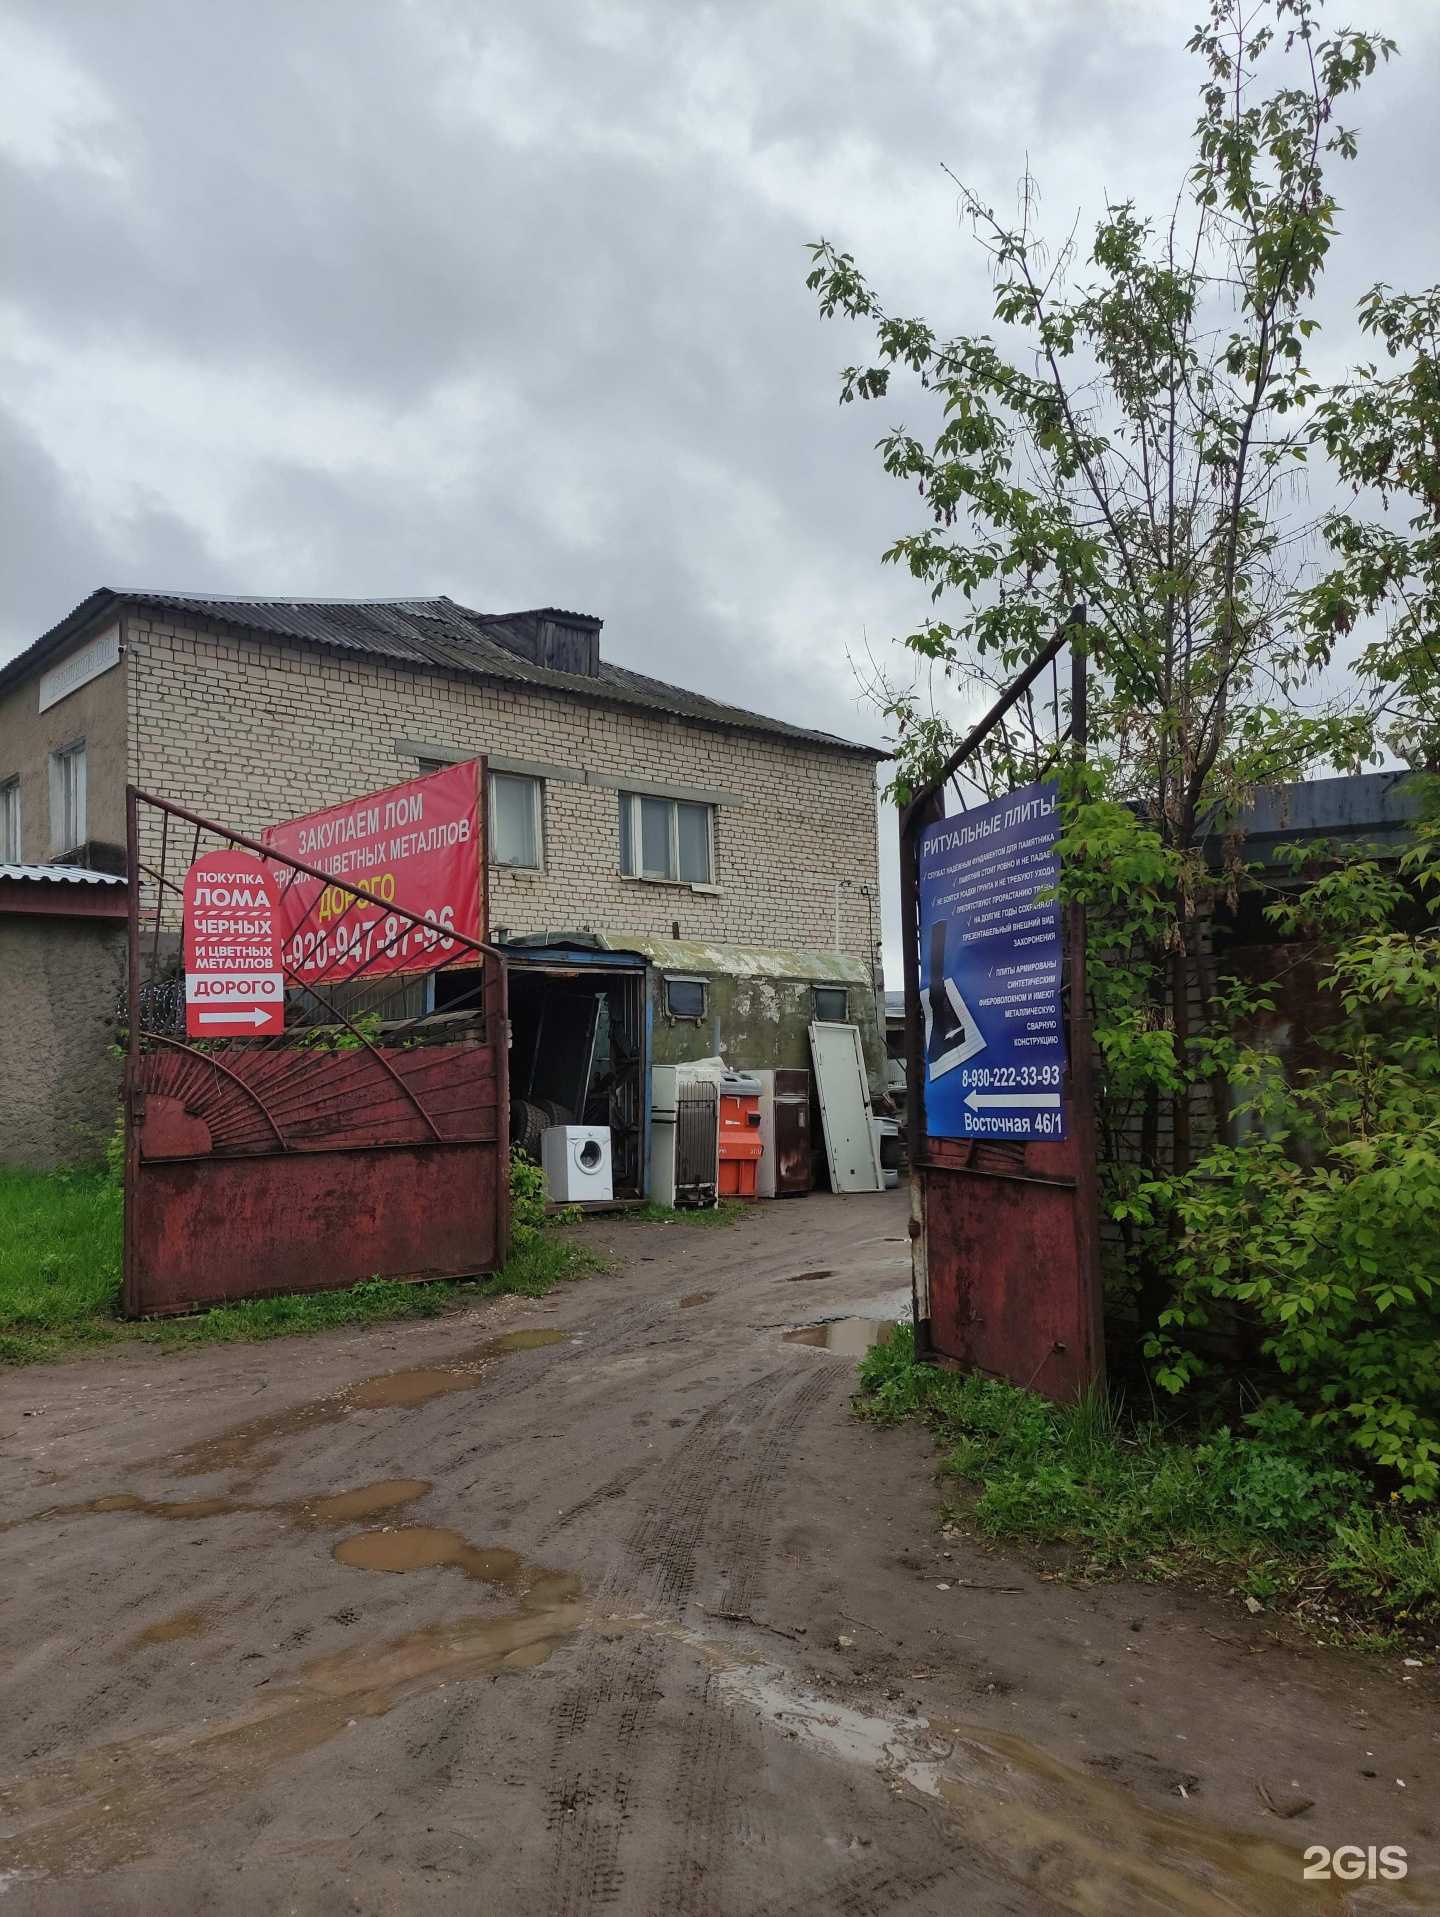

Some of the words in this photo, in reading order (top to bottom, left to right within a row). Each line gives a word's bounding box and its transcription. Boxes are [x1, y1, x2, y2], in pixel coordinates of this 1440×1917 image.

[298, 807, 380, 855] ЗАКУПАЕМ
[384, 793, 423, 831] ЛОМ
[923, 814, 1002, 857] РИТУАЛЬНЫЕ
[1018, 833, 1055, 850] ПАМЯТНИКА
[273, 863, 310, 889] ЕРНЫХ
[323, 841, 386, 876] ЦВЕТНЫХ
[390, 819, 470, 861] МЕТАЛЛОВ
[1022, 855, 1030, 865] НЕ
[196, 872, 265, 885] ПОКУПКА
[1007, 870, 1035, 885] ТРЕБУЮТ
[1034, 866, 1055, 879] УХОДА
[193, 888, 271, 907] ЛОМА
[319, 873, 395, 922] ДОРОГО
[992, 887, 1033, 904] ПРОРАСТАНИЮ
[194, 919, 273, 934] ЧЕРНЫХ
[962, 923, 1012, 942] ПРЕЗЕНТАБЕЛЬНЫЙ
[1012, 916, 1041, 931] ВНЕШНИЙ
[1041, 915, 1055, 925] ВИД
[281, 905, 455, 971] -920-947-87-96
[1013, 932, 1056, 947] ЗАХОРОНЕНИЯ
[195, 946, 206, 957] И
[208, 946, 273, 958] ЦВЕТНЫХ
[195, 958, 274, 969] МЕТАЛЛОВ
[194, 980, 276, 997] ДОРОГО
[1004, 1004, 1056, 1018] МЕТАЛЛИЧЕСКУЮ
[1026, 1020, 1057, 1031] СВАРНУЮ
[1013, 1035, 1059, 1047] КОНСТРУКЦИЮ
[962, 1065, 1060, 1088] 8-930-222-33-93
[964, 1112, 1031, 1133] Восточная
[1034, 1113, 1062, 1134] 46/1
